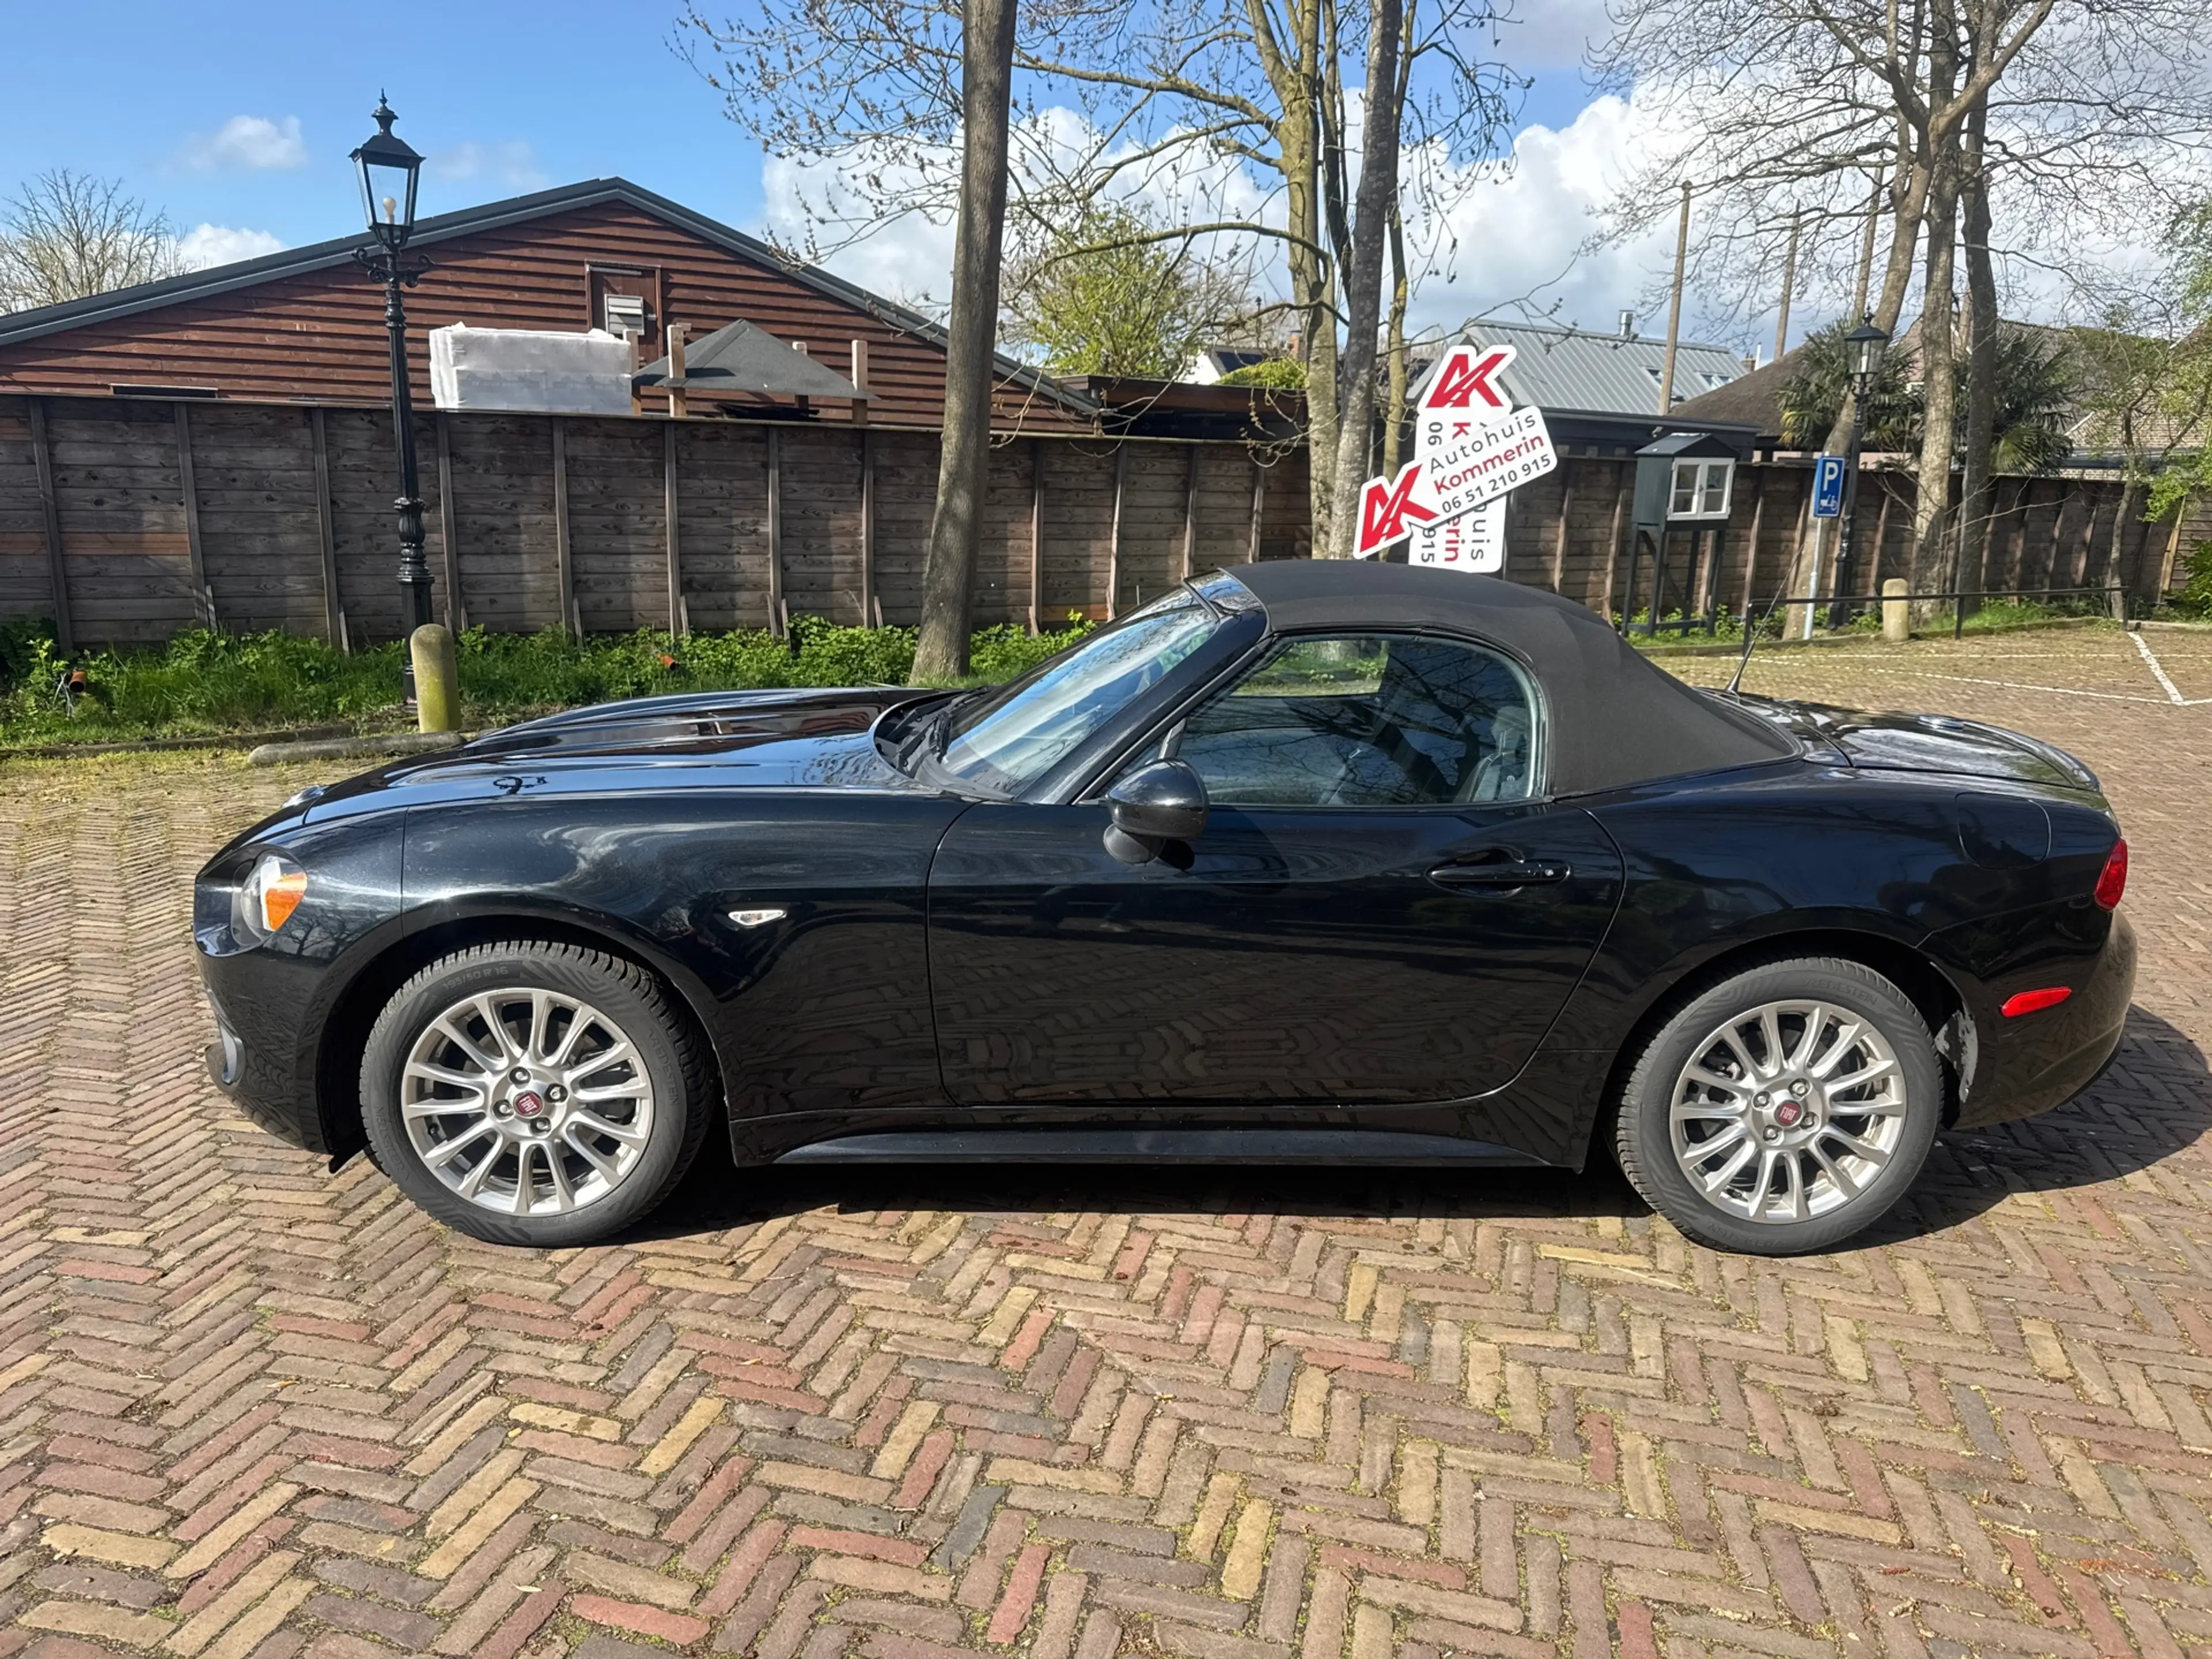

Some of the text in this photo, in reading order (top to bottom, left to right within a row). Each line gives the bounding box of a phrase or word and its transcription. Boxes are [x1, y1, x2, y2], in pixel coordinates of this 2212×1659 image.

[1427, 422, 1443, 446] 06
[1430, 414, 1536, 474] Autohuis
[1434, 435, 1544, 495] Kommerin
[1823, 462, 1839, 491] P
[1442, 453, 1551, 513] 06 51 210 915
[442, 966, 509, 990] 195/50 R 16
[1779, 1106, 1798, 1121] FIAT
